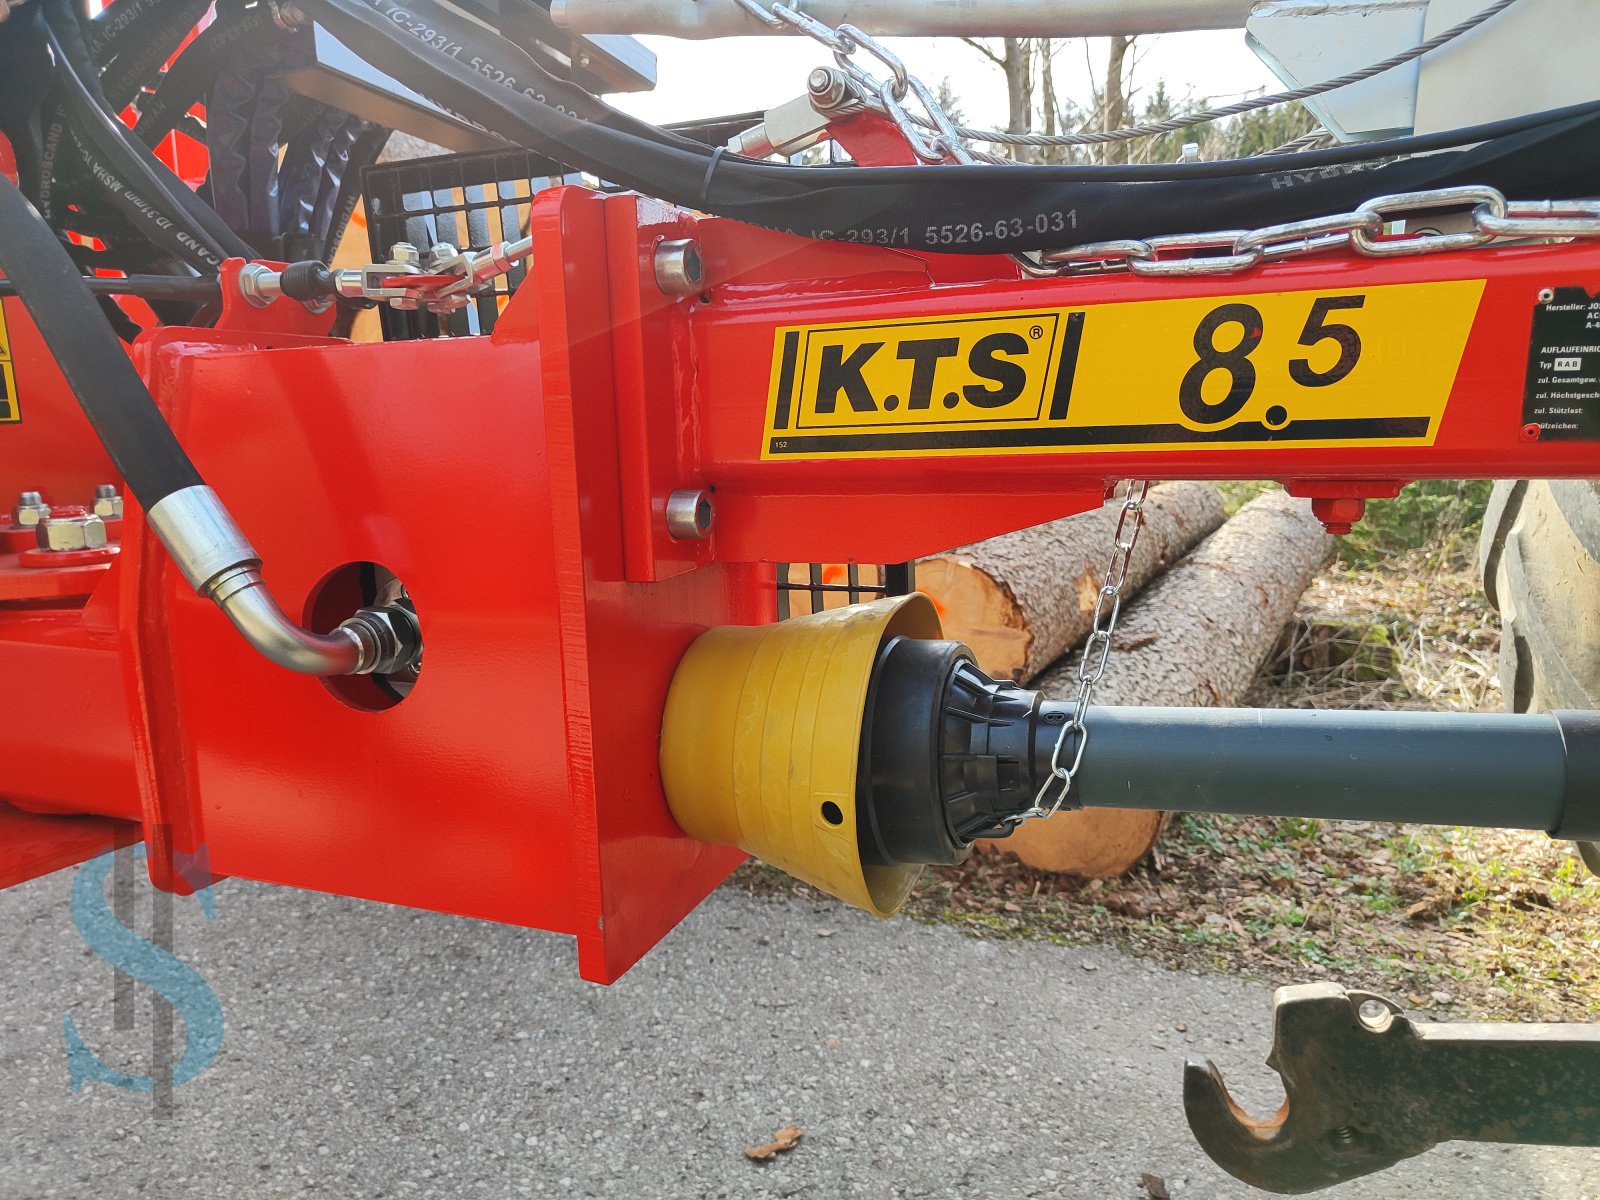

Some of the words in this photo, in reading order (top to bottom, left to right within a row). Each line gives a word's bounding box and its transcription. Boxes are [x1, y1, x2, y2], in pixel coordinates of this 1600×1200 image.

[925, 208, 1078, 246] 5526-63-031
[1546, 303, 1586, 311] Hersteller:
[1178, 294, 1367, 425] 8.5
[1540, 361, 1552, 370] Typ
[1552, 376, 1598, 385] Gesamtgew.
[774, 440, 788, 449] 152
